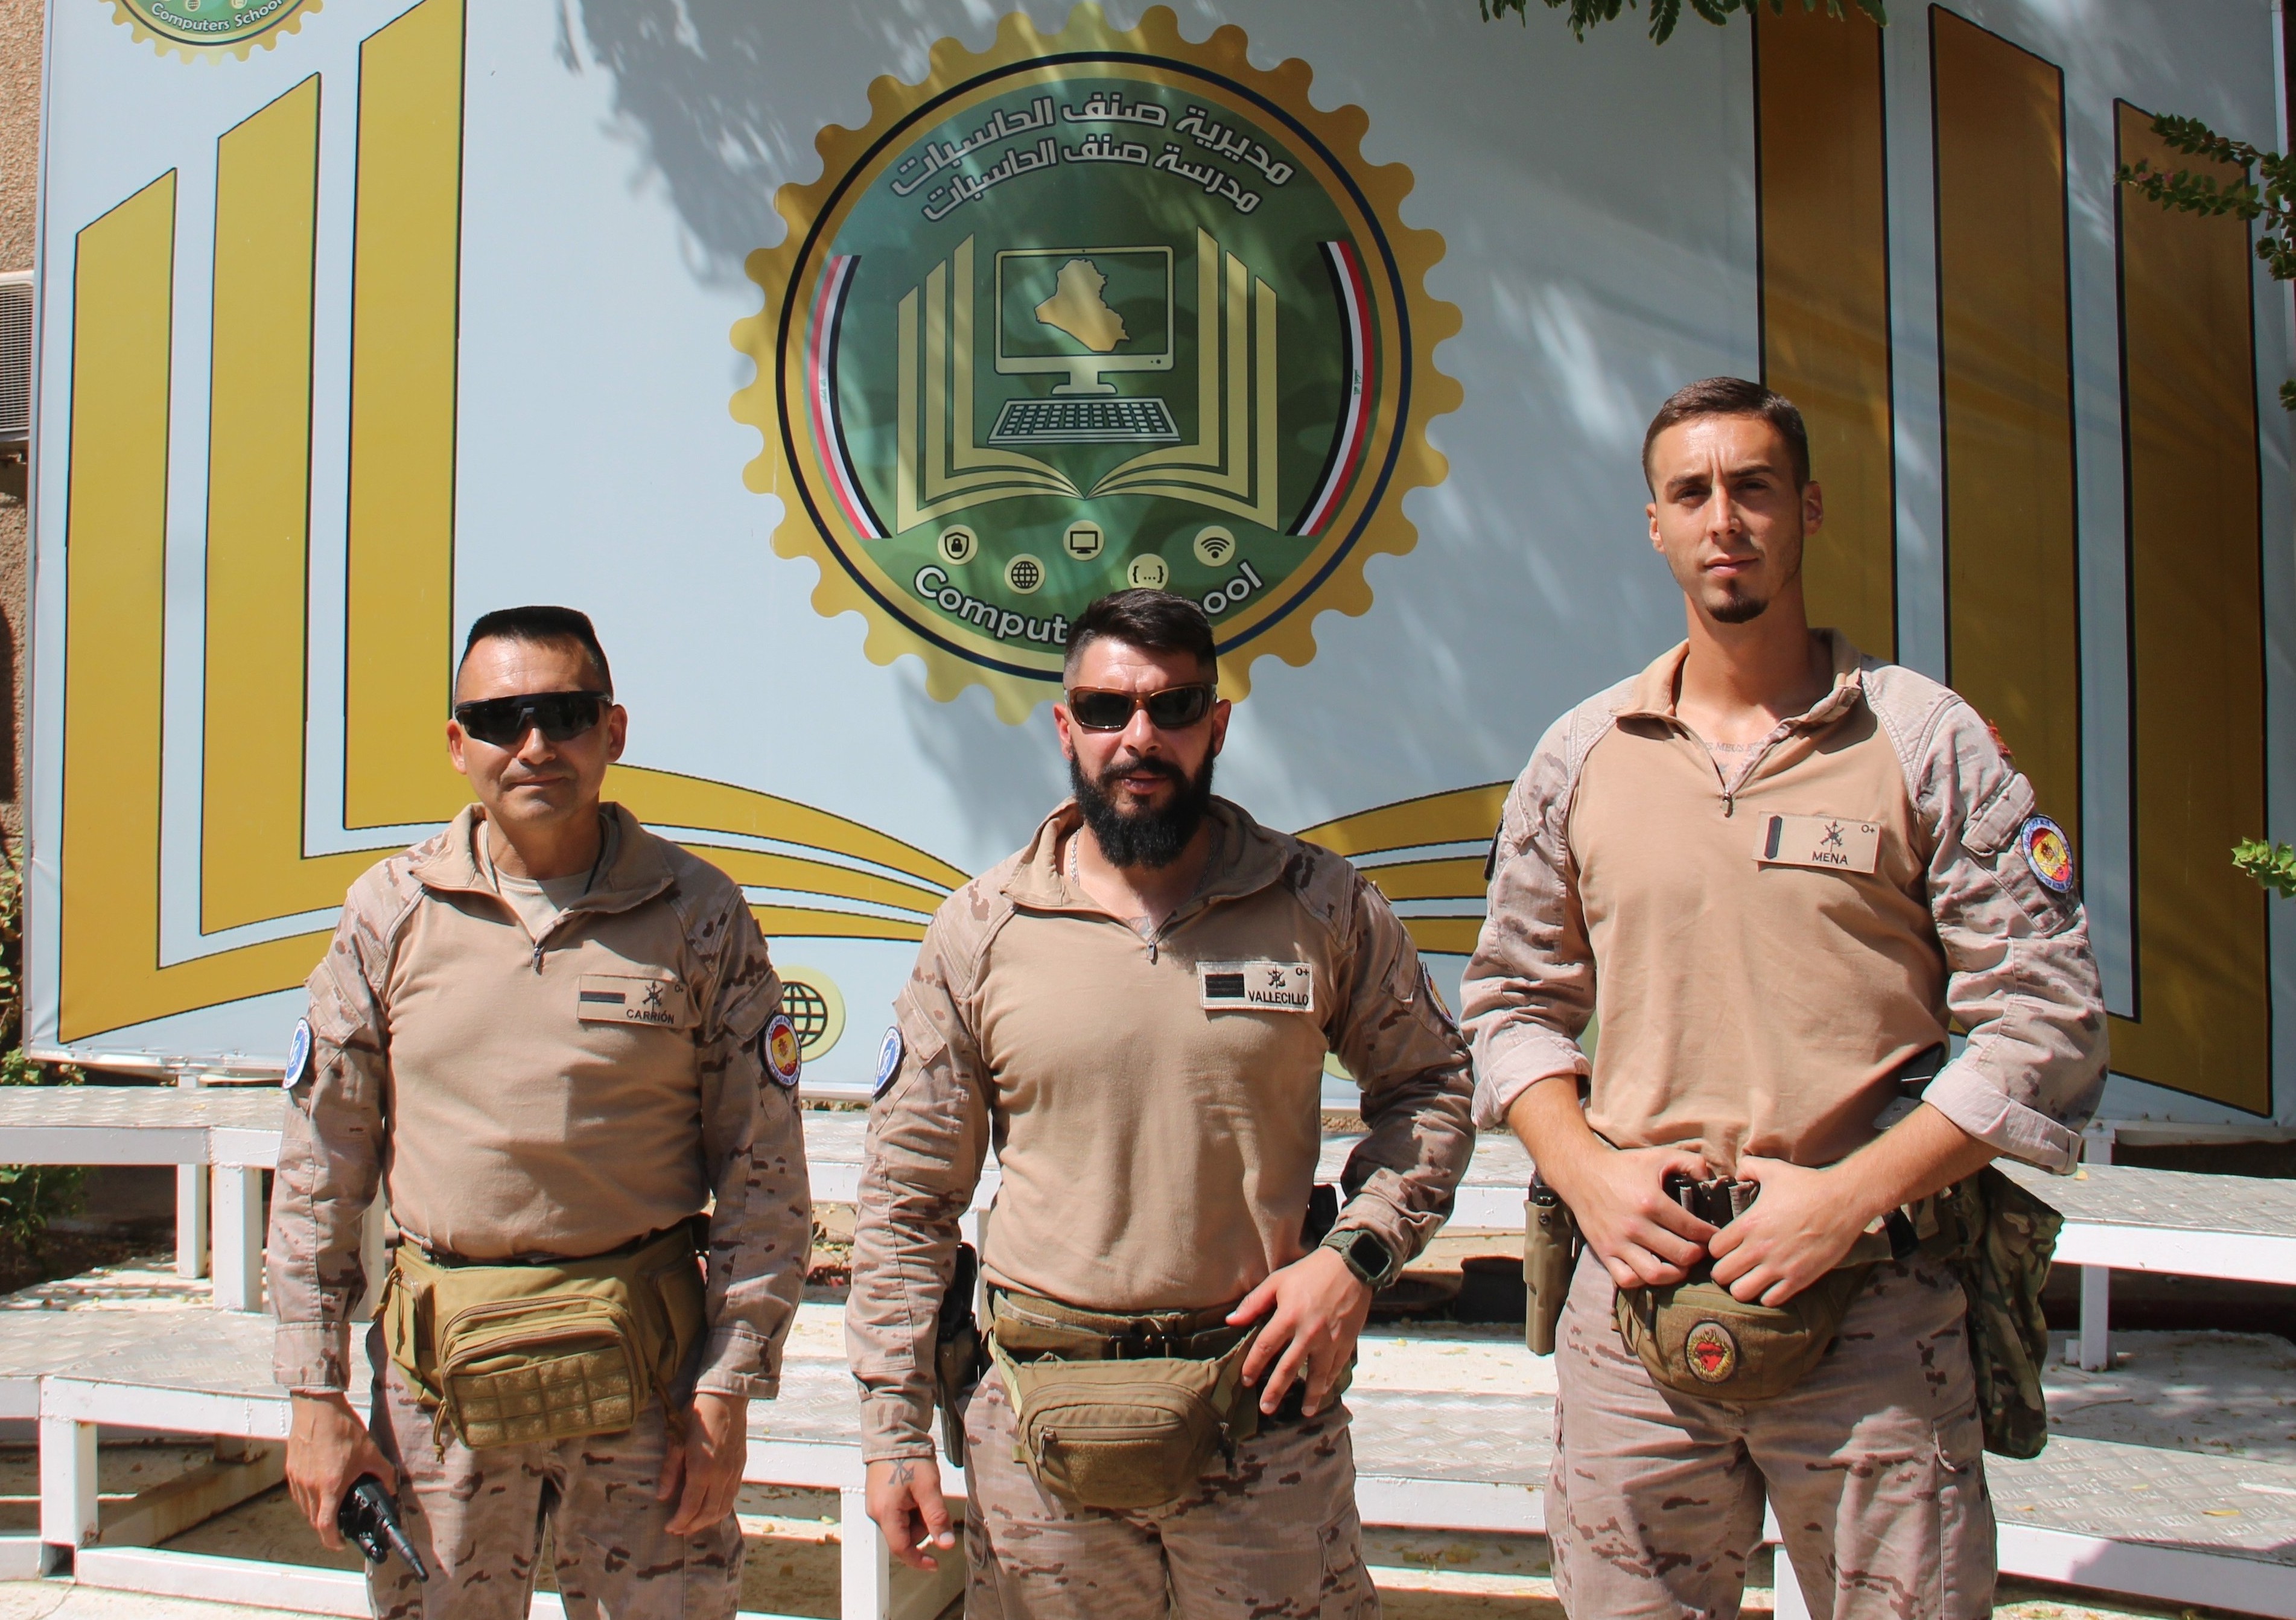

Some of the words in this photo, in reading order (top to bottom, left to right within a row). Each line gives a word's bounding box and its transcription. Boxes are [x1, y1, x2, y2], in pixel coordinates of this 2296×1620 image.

[151, 2, 230, 31] Computers
[1062, 93, 1168, 127] صنف
[891, 97, 1055, 195] الحاسبات
[1063, 135, 1149, 164] صنف
[1175, 107, 1294, 185] مديرية
[923, 139, 1063, 220] الحاسبات
[1154, 144, 1261, 213] مدرسة
[915, 566, 1068, 644] Comput
[1203, 561, 1262, 614] ool
[1811, 851, 1848, 865] MENA
[1248, 990, 1309, 1006] VALLECILLO
[626, 1009, 675, 1024] CARRIÓN
